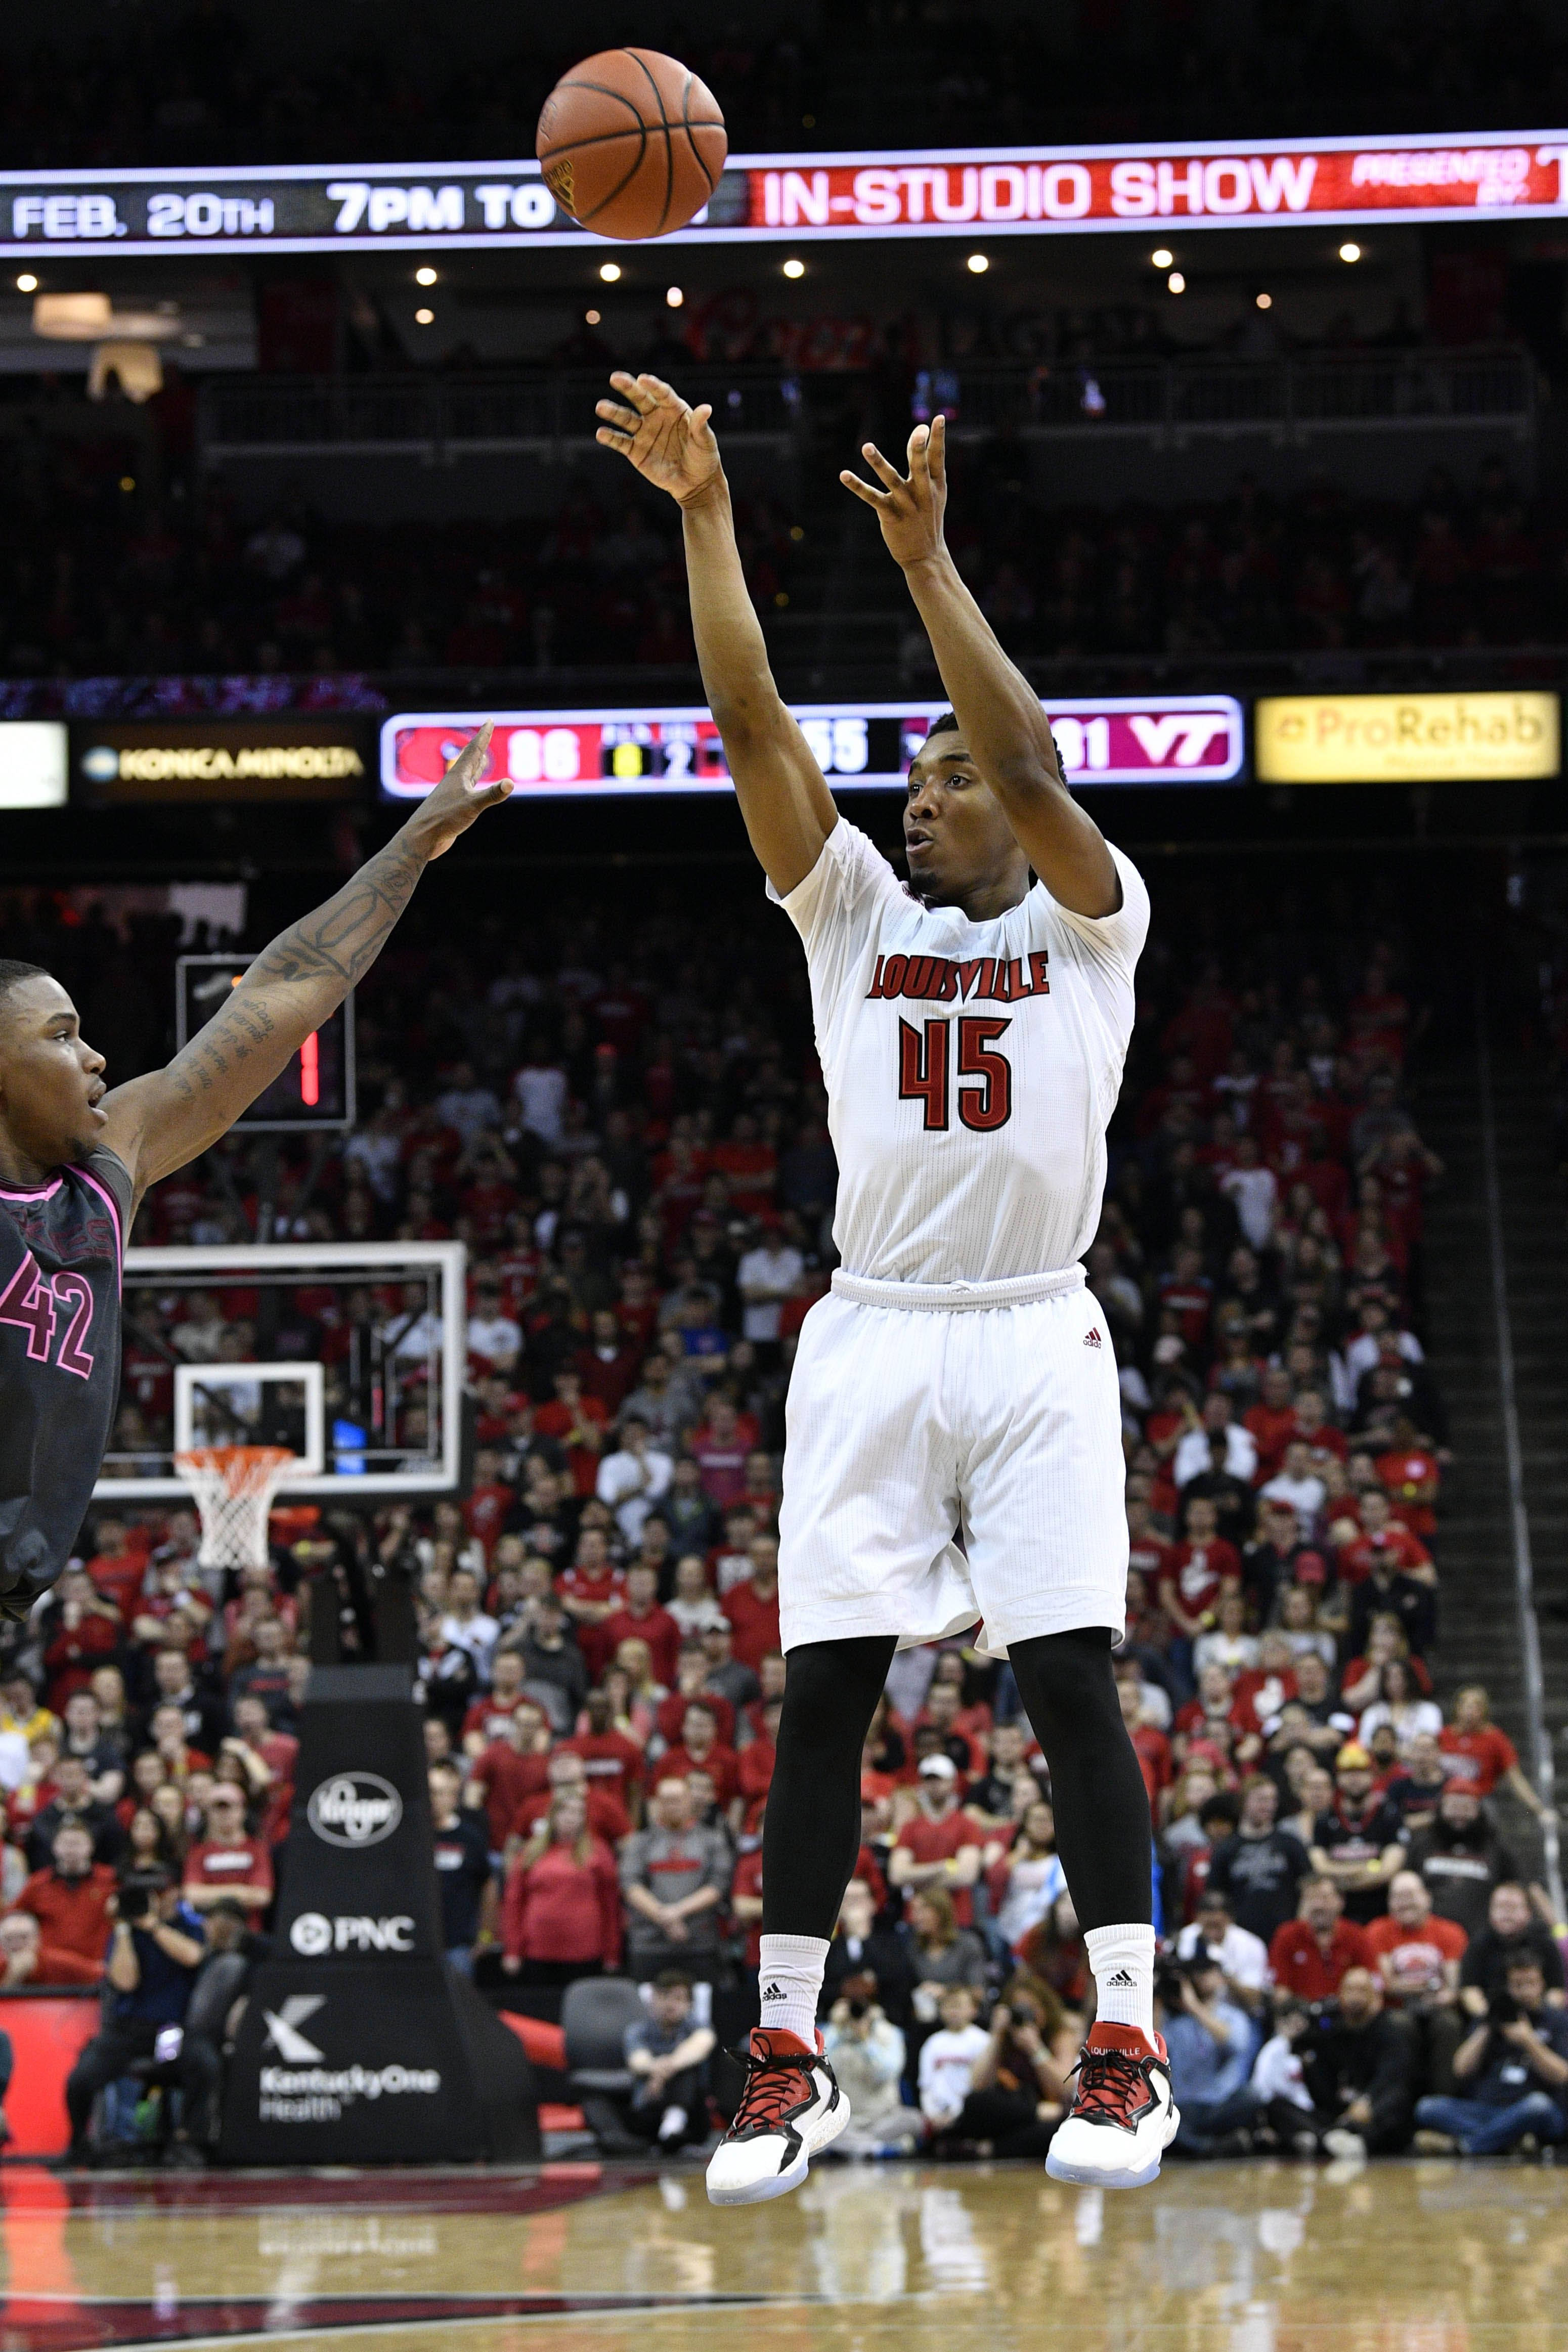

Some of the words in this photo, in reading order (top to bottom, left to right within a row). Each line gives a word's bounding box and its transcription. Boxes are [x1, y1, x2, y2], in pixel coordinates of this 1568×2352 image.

[13, 194, 127, 238] FEB.
[147, 193, 274, 237] 20TH
[326, 182, 464, 233] 7PM
[764, 163, 1092, 227] IN-STUDIO
[1111, 156, 1318, 217] SHOW
[1128, 715, 1229, 766] VT
[1315, 699, 1547, 750] ProRehab
[865, 950, 1050, 1006] LOUISVILLE
[899, 1015, 1013, 1132] 45
[0, 1250, 94, 1380] 42
[1083, 1339, 1102, 1349] adida
[333, 1915, 416, 1952] PNC
